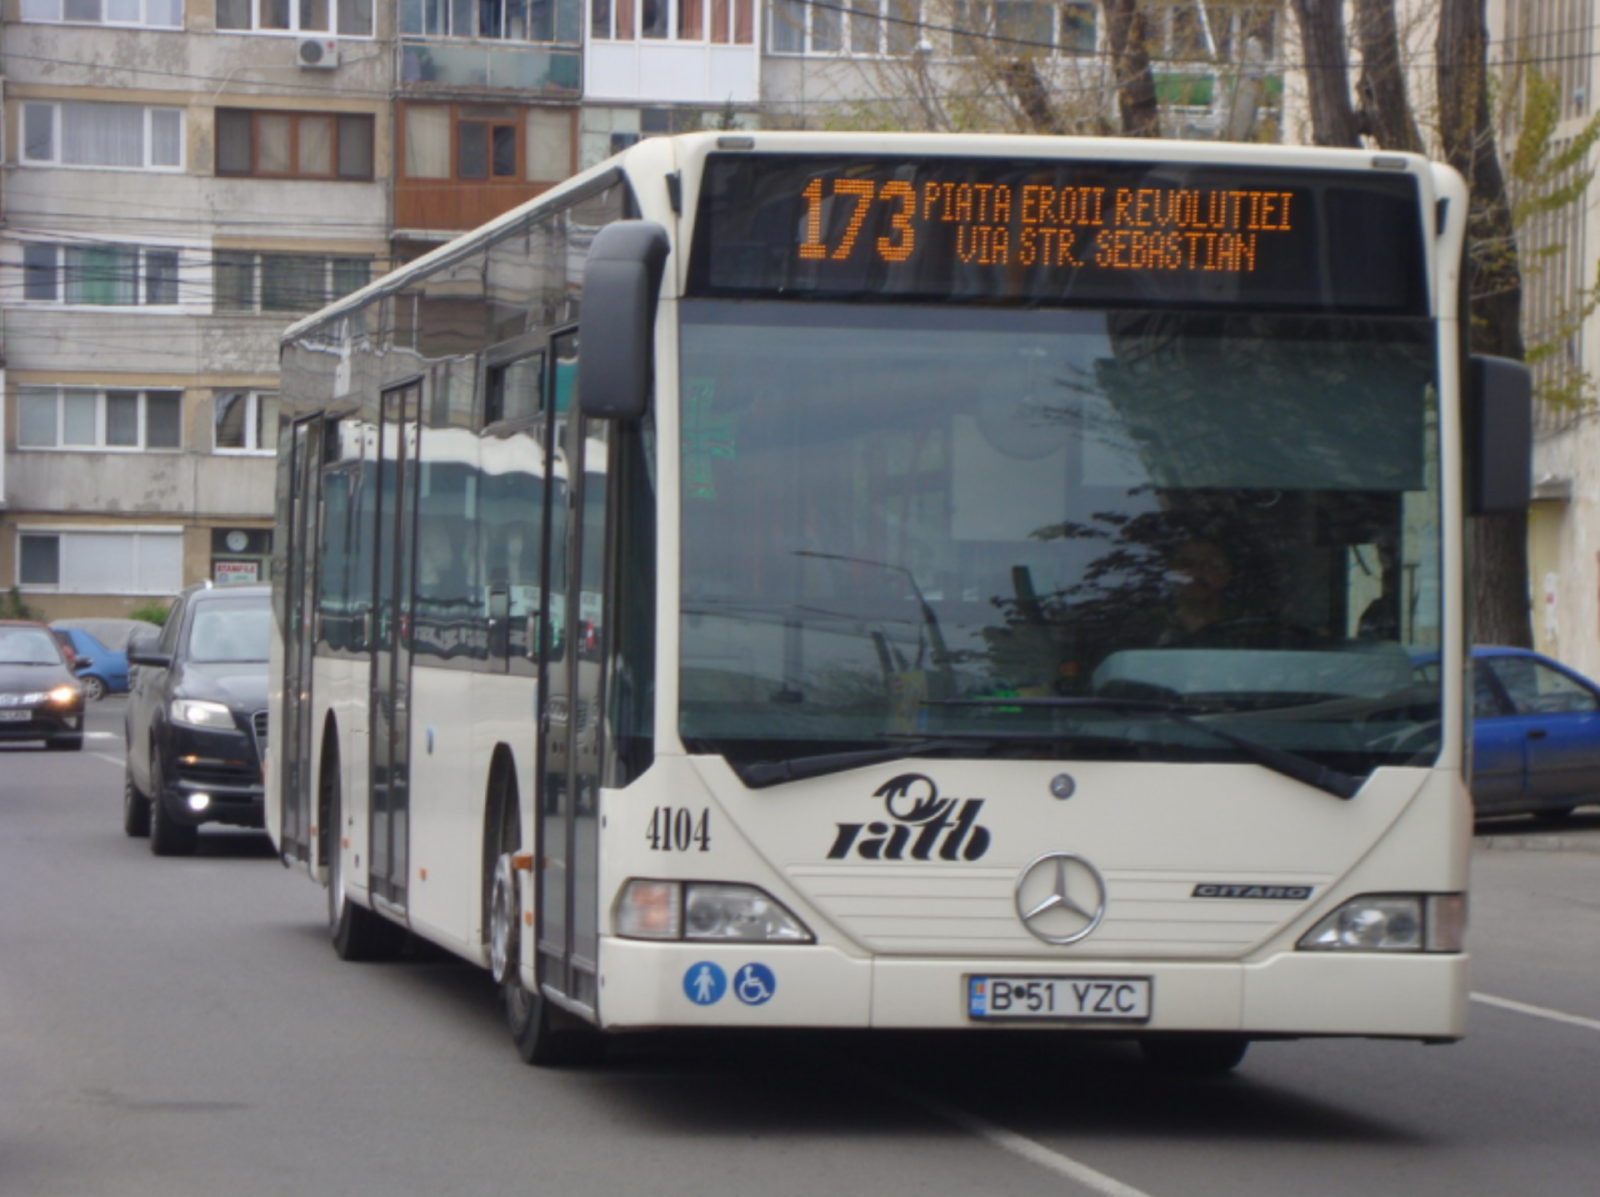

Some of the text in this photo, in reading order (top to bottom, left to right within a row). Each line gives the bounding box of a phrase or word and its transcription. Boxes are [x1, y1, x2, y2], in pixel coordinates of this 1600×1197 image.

[799, 178, 916, 261] 173
[924, 182, 1294, 231] PIATA EROII REVOLUTIEI
[957, 225, 1257, 272] VIA STR. SEBASTIAN
[646, 806, 711, 852] 4104
[1196, 885, 1308, 899] CITARO
[1072, 983, 1135, 1013] YZC
